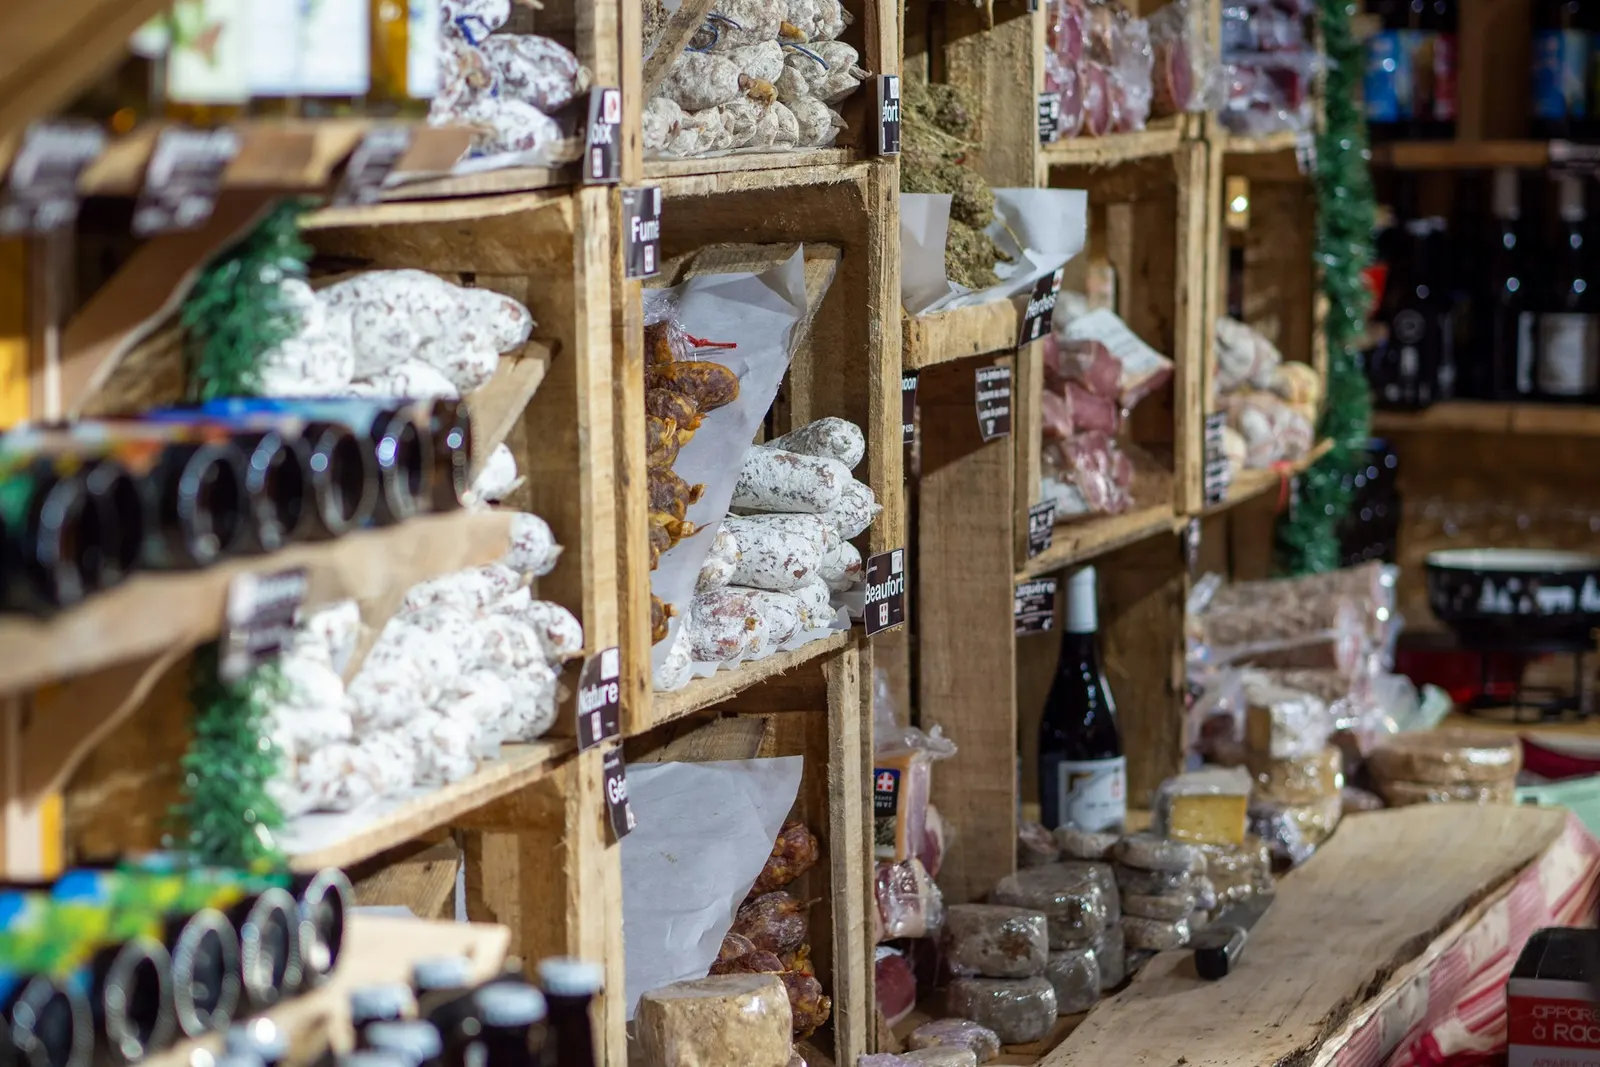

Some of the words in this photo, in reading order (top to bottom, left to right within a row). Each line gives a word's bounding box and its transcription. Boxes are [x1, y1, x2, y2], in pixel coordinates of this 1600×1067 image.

[882, 100, 898, 122] fort
[865, 572, 904, 605] Beaufort
[578, 681, 619, 717] Nature
